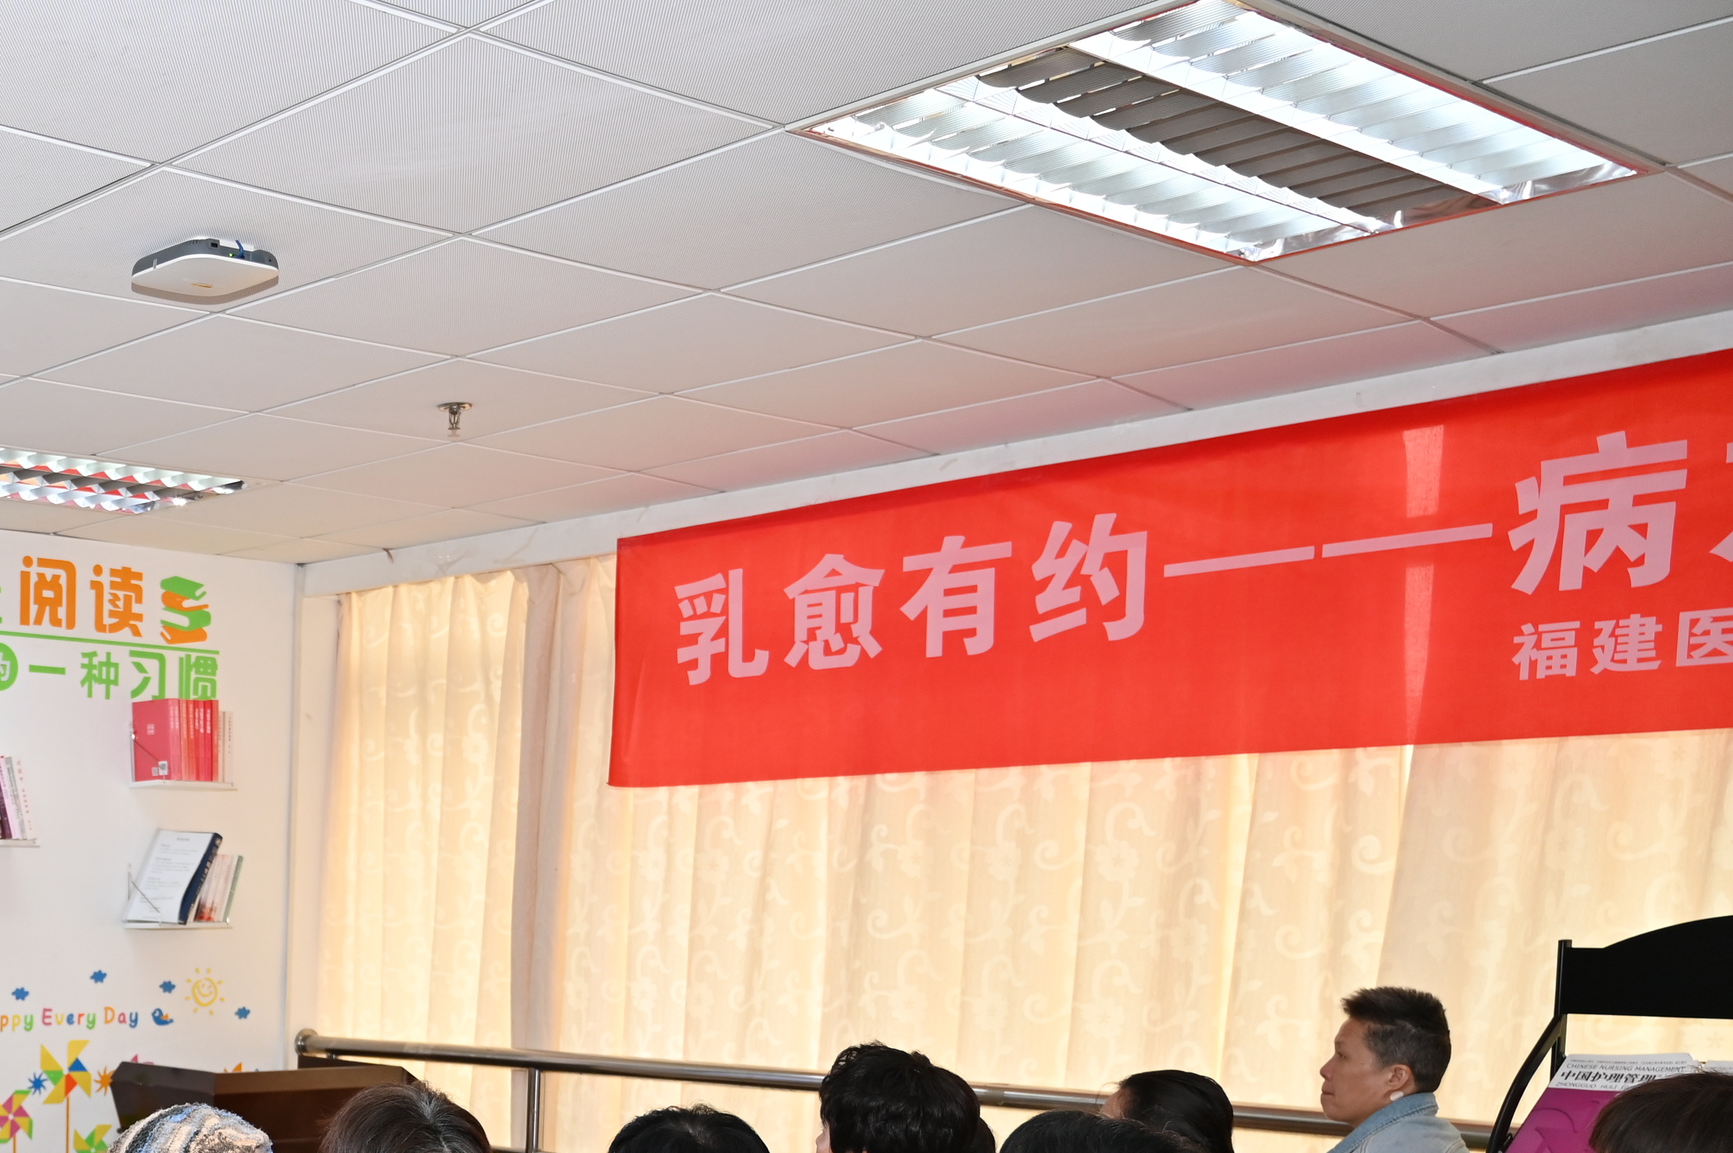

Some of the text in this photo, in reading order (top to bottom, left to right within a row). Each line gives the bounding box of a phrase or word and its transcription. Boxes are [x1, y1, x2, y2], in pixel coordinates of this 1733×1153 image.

[673, 430, 1733, 686] 乳愈有约——病
[1512, 607, 1733, 681] 福建医
[42, 1008, 97, 1030] Every
[103, 1006, 139, 1028] Day
[1634, 1065, 1687, 1073] MANAGEMENT
